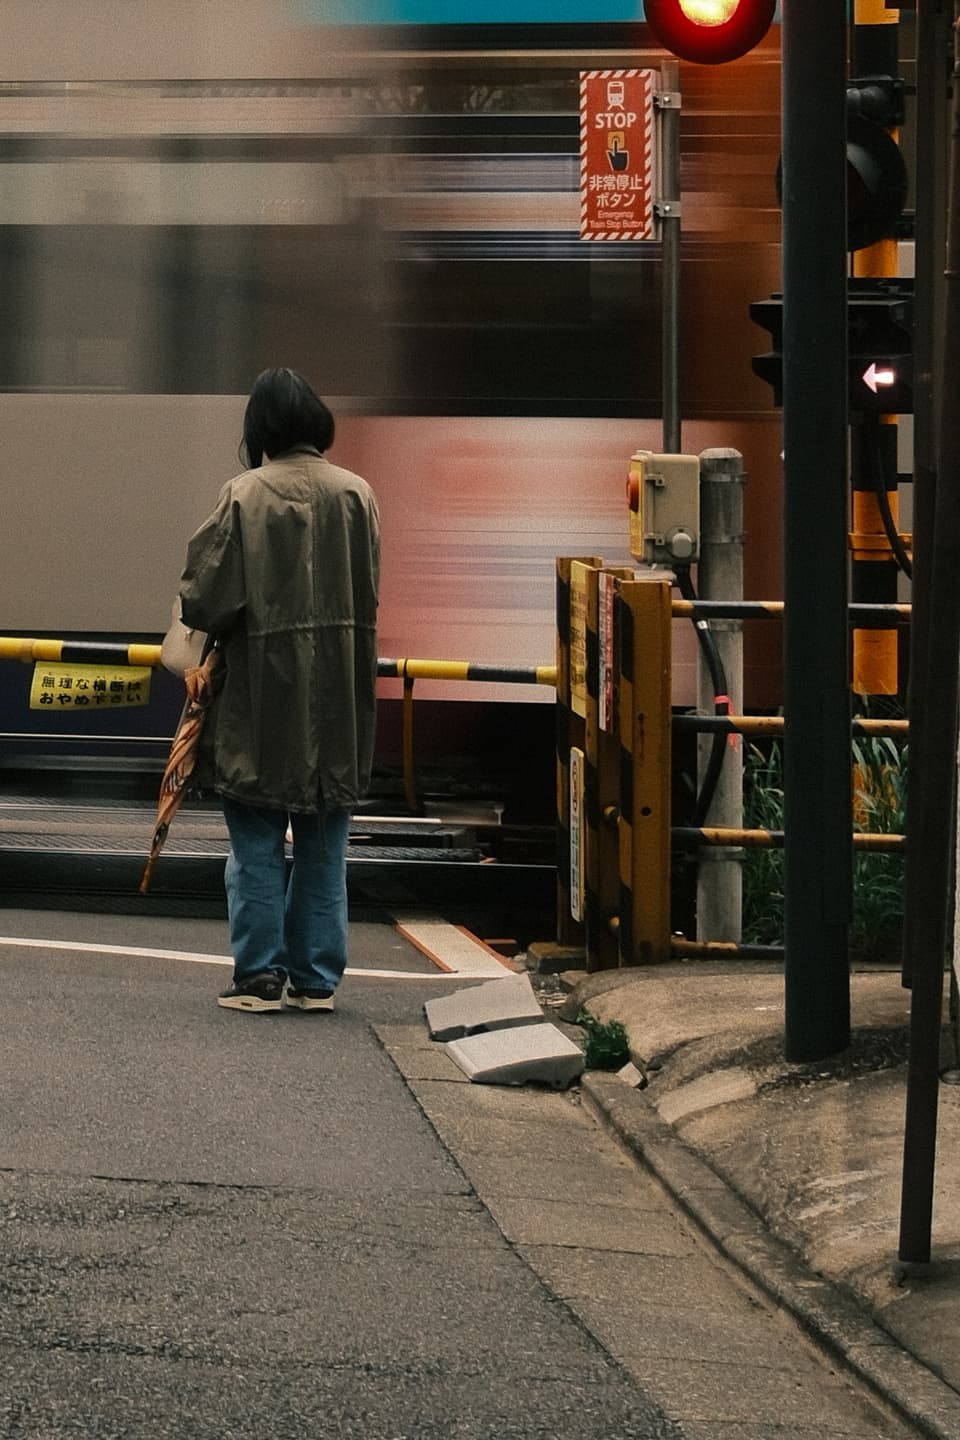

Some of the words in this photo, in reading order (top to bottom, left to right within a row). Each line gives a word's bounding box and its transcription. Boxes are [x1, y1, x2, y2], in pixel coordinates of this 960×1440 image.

[595, 113, 637, 129] STOP
[589, 174, 643, 191] 非常停止
[596, 194, 636, 208] ボタン
[597, 210, 634, 220] Emergency
[606, 220, 621, 230] Stop
